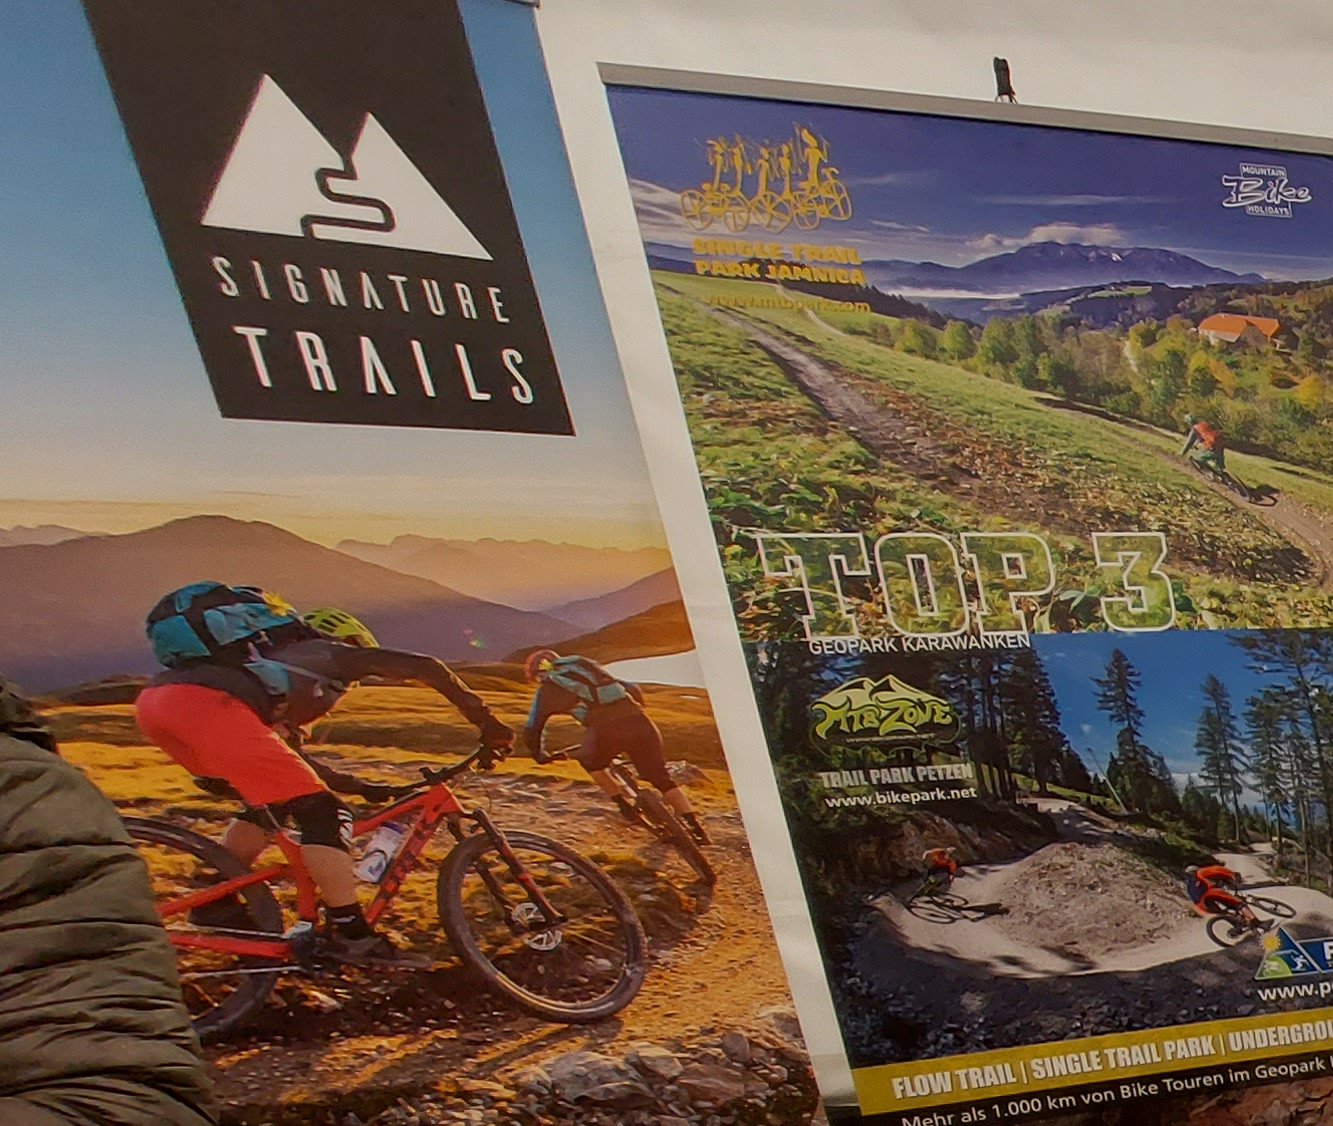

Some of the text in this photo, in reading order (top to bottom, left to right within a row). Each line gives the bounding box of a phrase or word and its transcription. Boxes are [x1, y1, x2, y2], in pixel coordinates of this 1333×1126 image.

[1242, 166, 1285, 176] MOUNTAIN
[1222, 175, 1312, 207] Bike
[692, 238, 862, 265] SINGLE TRAIL
[694, 260, 865, 285] PARK JAMNICA
[212, 255, 510, 324] SIGNATURE
[232, 326, 534, 405] TRAILS
[756, 532, 1176, 641] TOP 3
[809, 633, 1031, 655] GEOPARK KARAWANKEN
[820, 764, 974, 788] TRAIL PARK PETZEN
[825, 787, 977, 809] www.bikepark.net
[891, 1074, 952, 1100] FLOW
[956, 1063, 1016, 1089] TRAIL
[1032, 1053, 1102, 1079] SINGLE
[1103, 1044, 1163, 1070] TRAIL
[1164, 1035, 1215, 1060] PARK
[960, 1103, 987, 1124] als
[993, 1097, 1042, 1119] 1.000
[1047, 1091, 1076, 1110] km
[1080, 1088, 1116, 1107] von
[1121, 1079, 1159, 1100] Bike
[1163, 1071, 1224, 1095] Touren
[1229, 1067, 1250, 1083] im
[1254, 1057, 1326, 1082] Geopark
